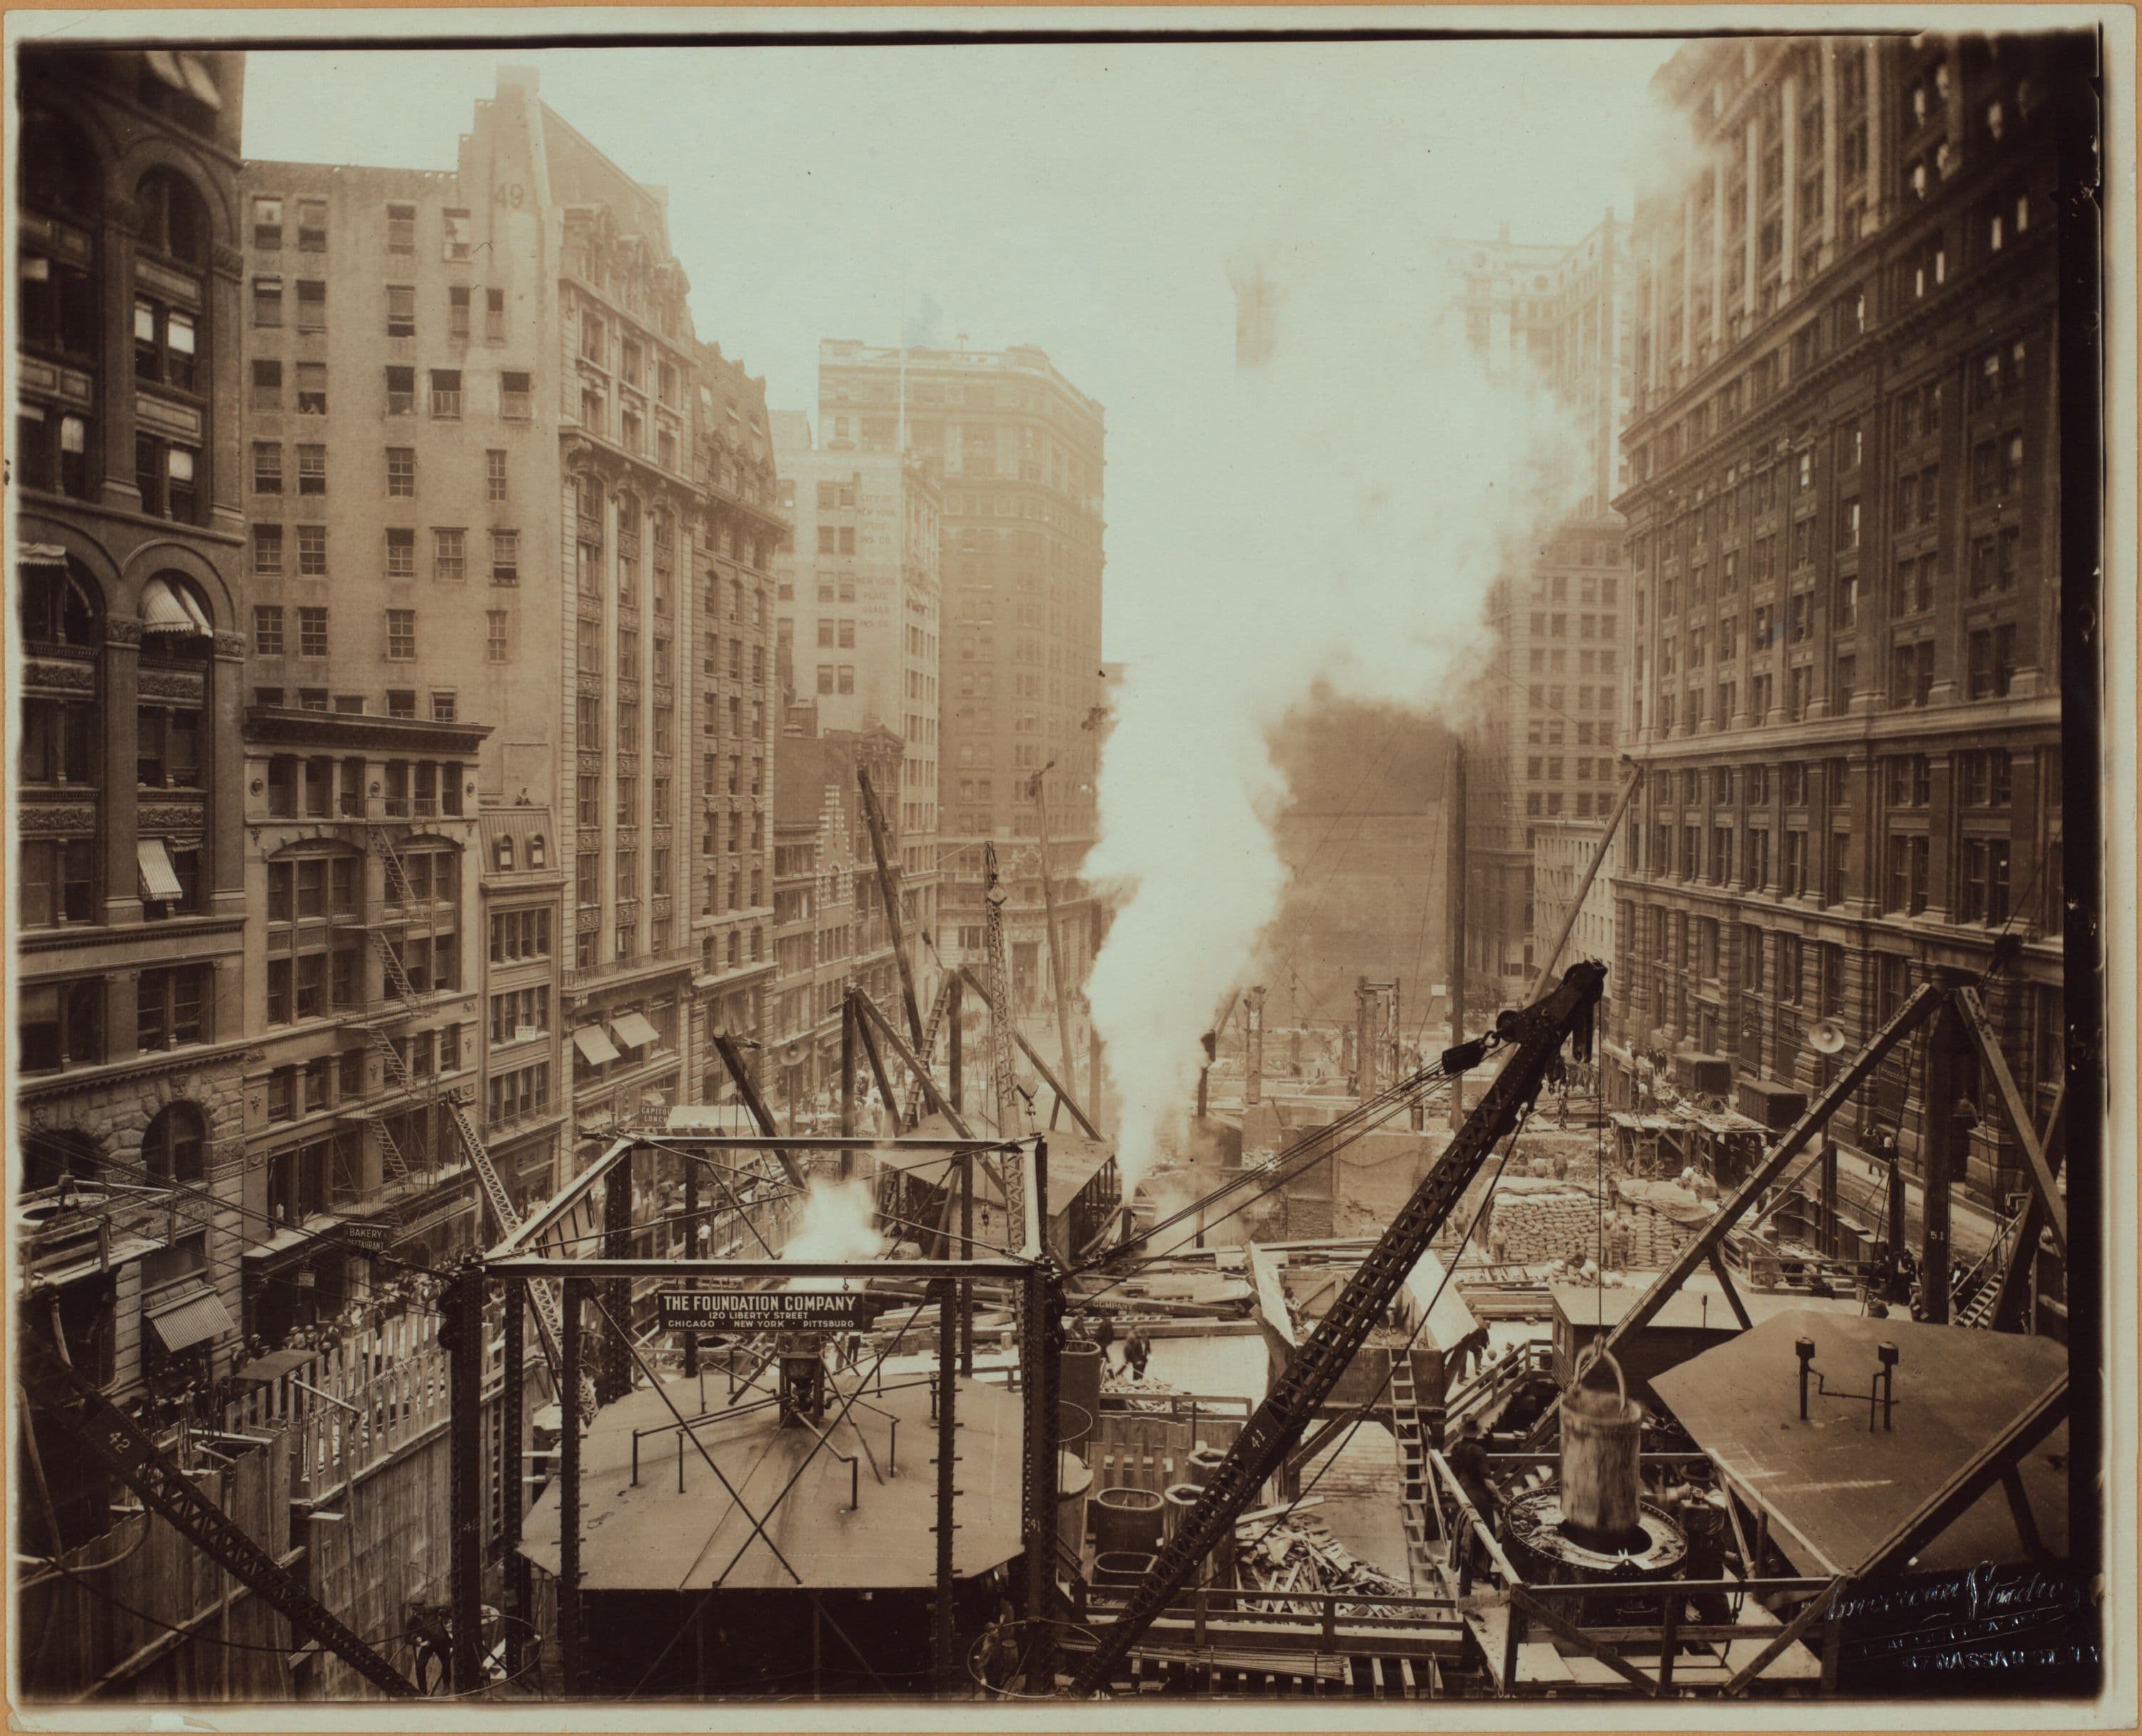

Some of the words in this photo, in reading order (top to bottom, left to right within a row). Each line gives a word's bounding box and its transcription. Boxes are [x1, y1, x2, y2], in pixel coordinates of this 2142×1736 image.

[493, 183, 525, 210] 49
[645, 1115, 668, 1124] LUNCH
[350, 1227, 383, 1239] BAKERY
[1930, 1231, 1944, 1241] 51
[663, 1296, 689, 1311] THE
[693, 1296, 779, 1311] FOUNDATION
[785, 1296, 856, 1311] COMPANY
[803, 1320, 855, 1328] PITTSBURG
[109, 1433, 130, 1453] 42
[1250, 1429, 1266, 1448] 41
